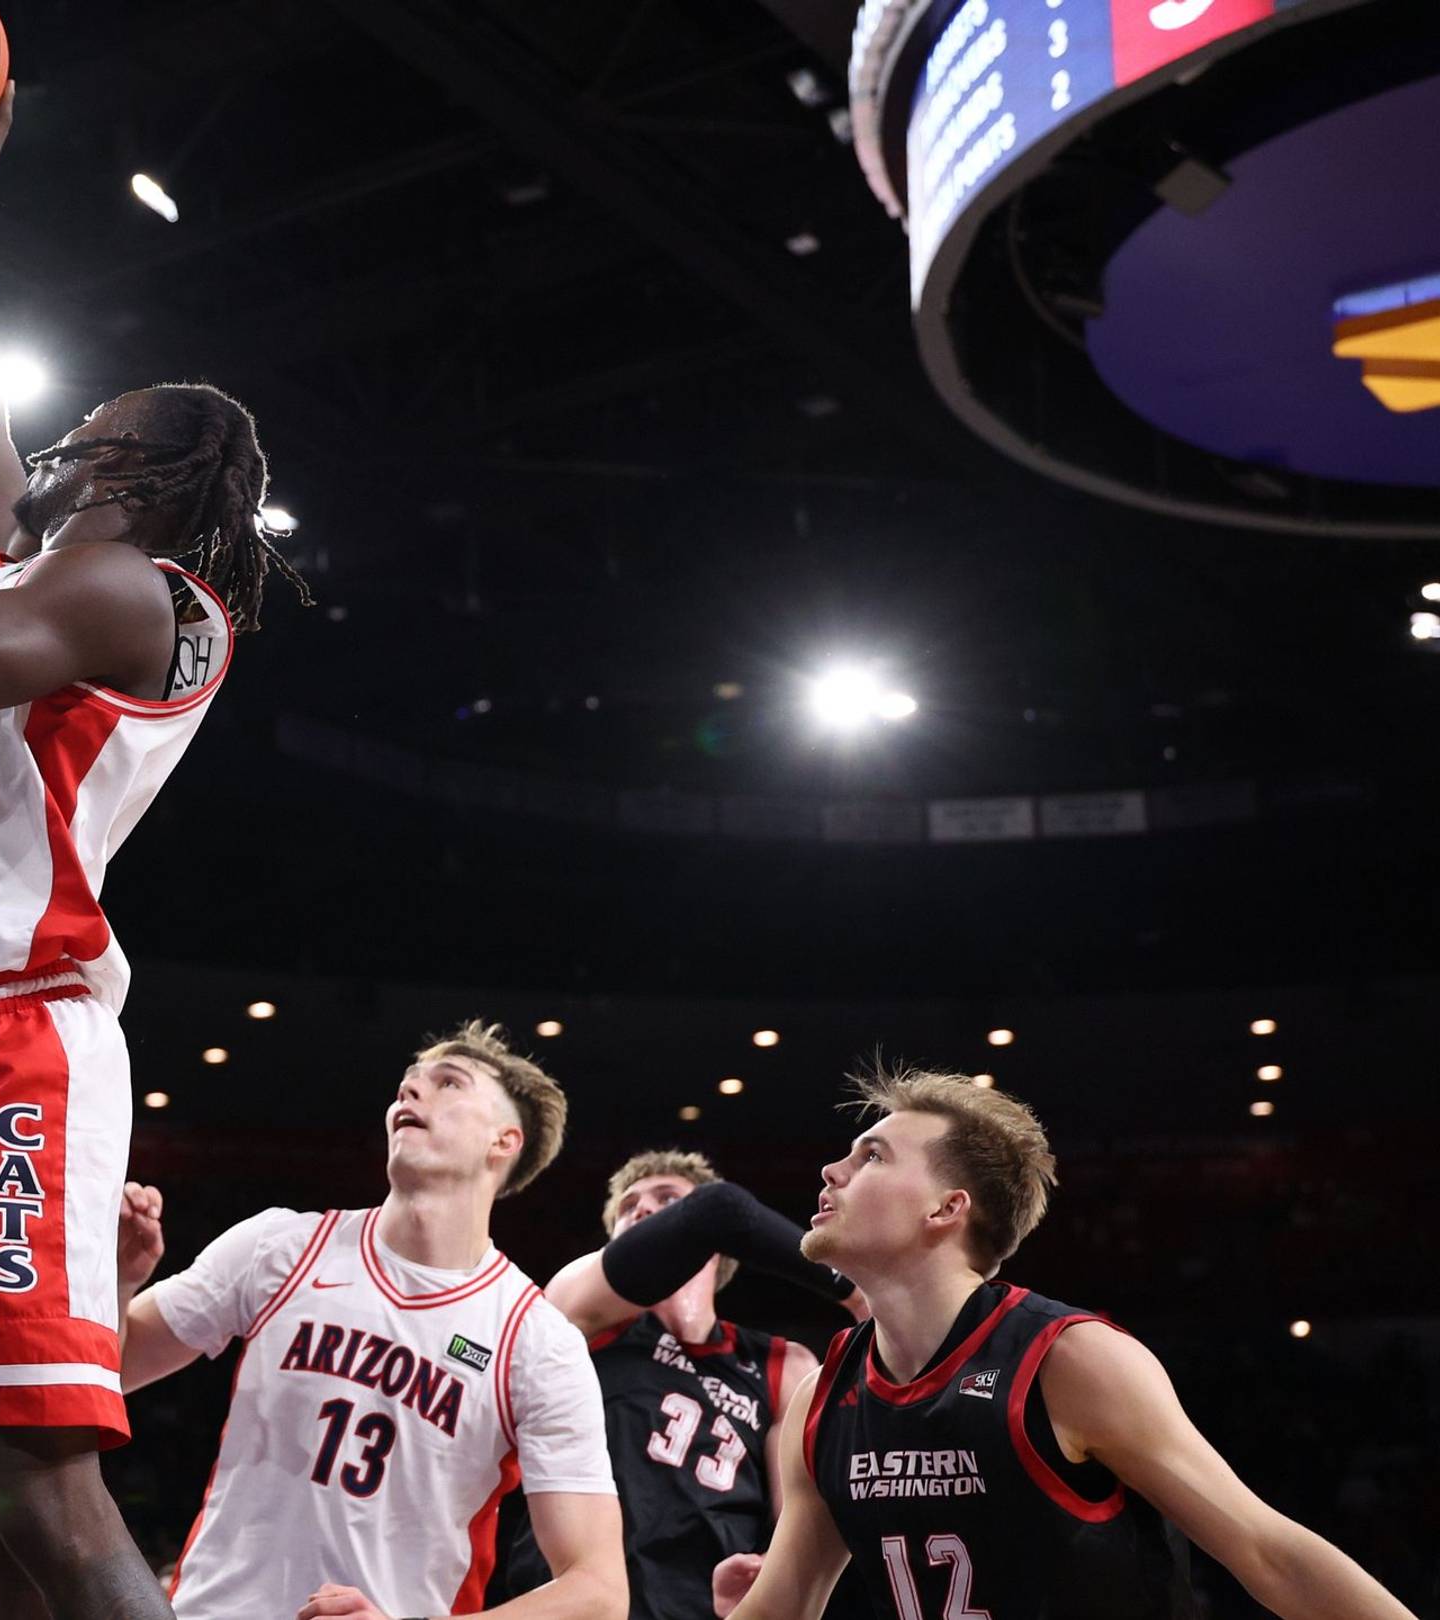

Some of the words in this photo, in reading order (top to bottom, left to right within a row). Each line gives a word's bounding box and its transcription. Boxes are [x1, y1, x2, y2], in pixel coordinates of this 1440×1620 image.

[174, 635, 213, 689] OH
[279, 1321, 464, 1438] ARIZONA
[975, 1372, 996, 1387] SKY
[311, 1397, 396, 1498] 13
[647, 1392, 747, 1491] 33
[849, 1450, 978, 1480] EASTERN
[850, 1476, 986, 1500] WASHINGTON
[881, 1534, 992, 1620] 12
